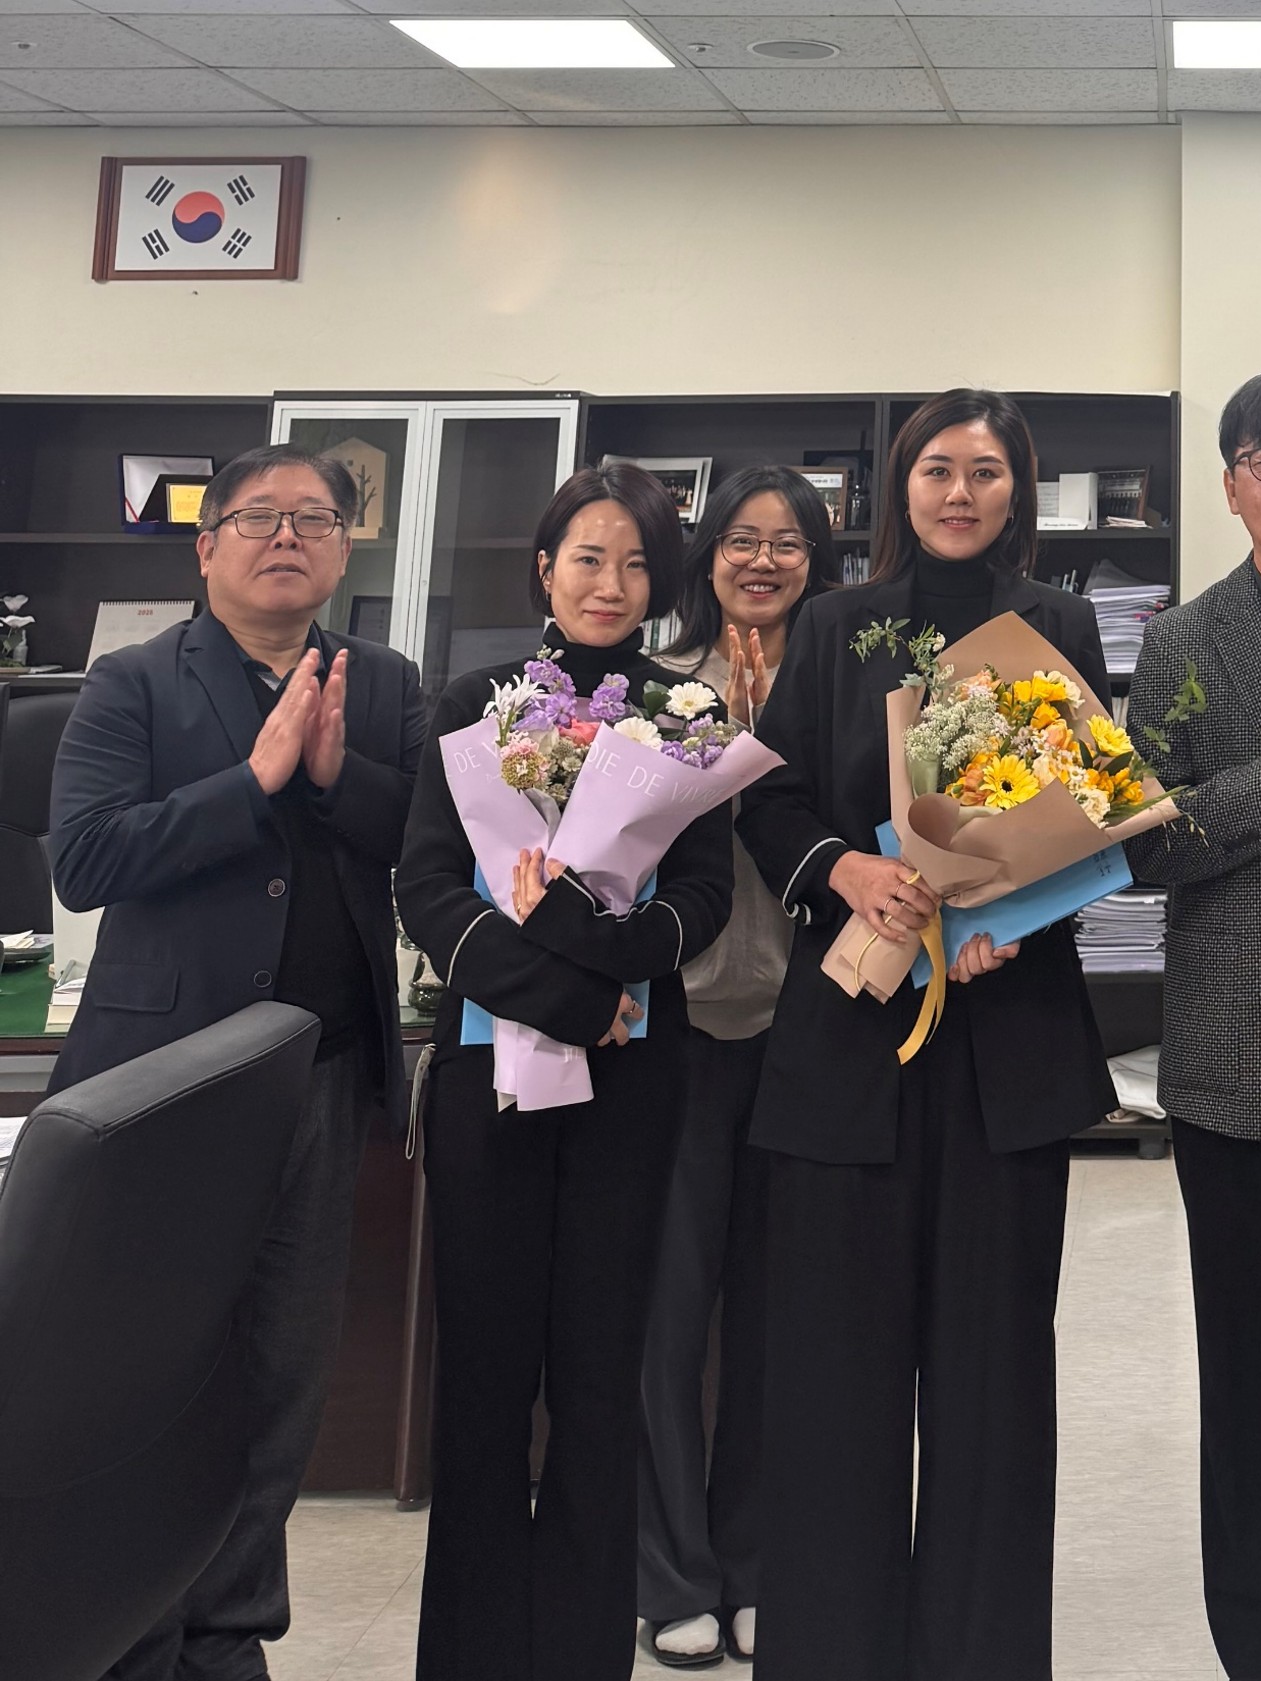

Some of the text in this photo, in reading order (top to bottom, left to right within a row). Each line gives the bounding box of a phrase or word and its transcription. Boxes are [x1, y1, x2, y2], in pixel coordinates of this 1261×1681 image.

[453, 747, 481, 774] DE
[587, 740, 621, 777] OIE
[627, 765, 665, 797] DE
